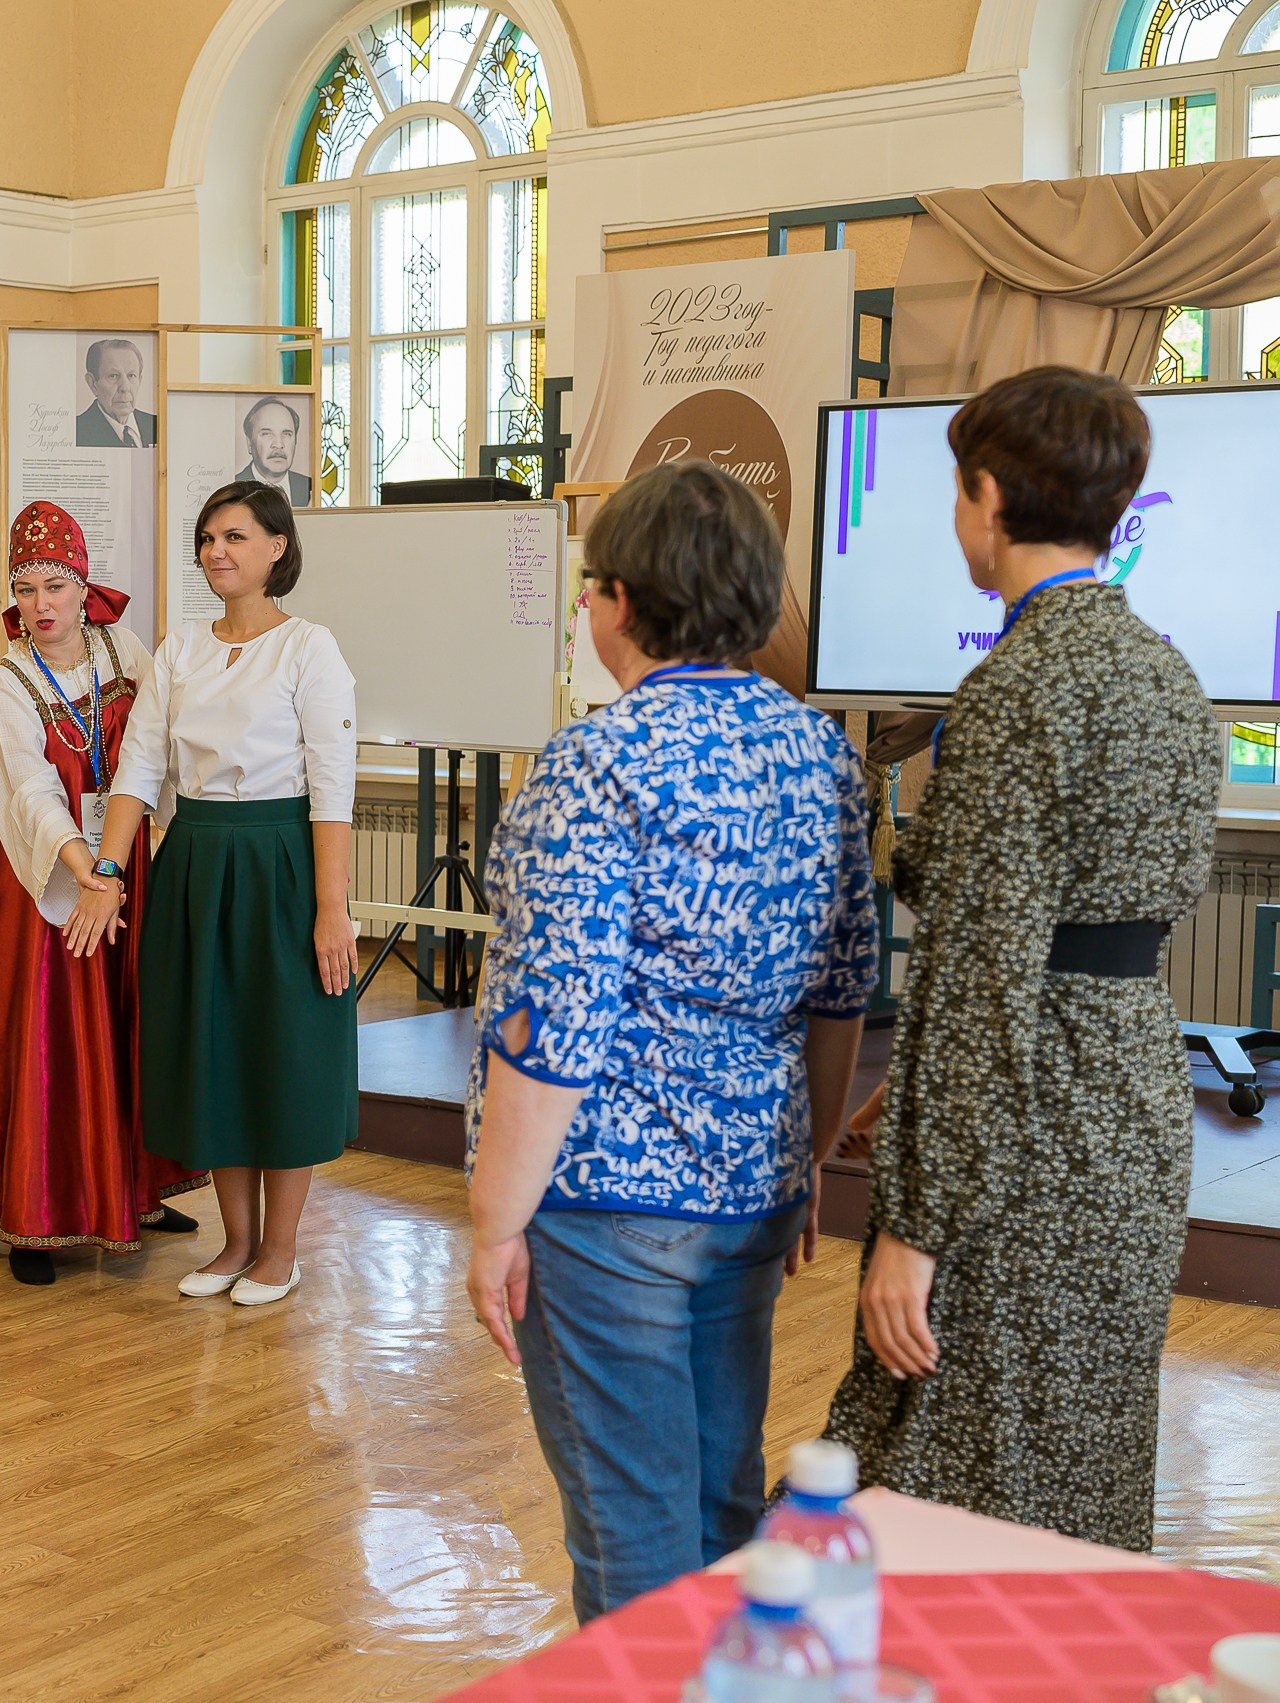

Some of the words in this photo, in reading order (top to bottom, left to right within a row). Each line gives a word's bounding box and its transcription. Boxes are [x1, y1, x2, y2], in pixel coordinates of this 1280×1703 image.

[643, 326, 684, 367] Год
[683, 331, 767, 365] педагога
[642, 369, 658, 386] и
[659, 352, 766, 385] наставника
